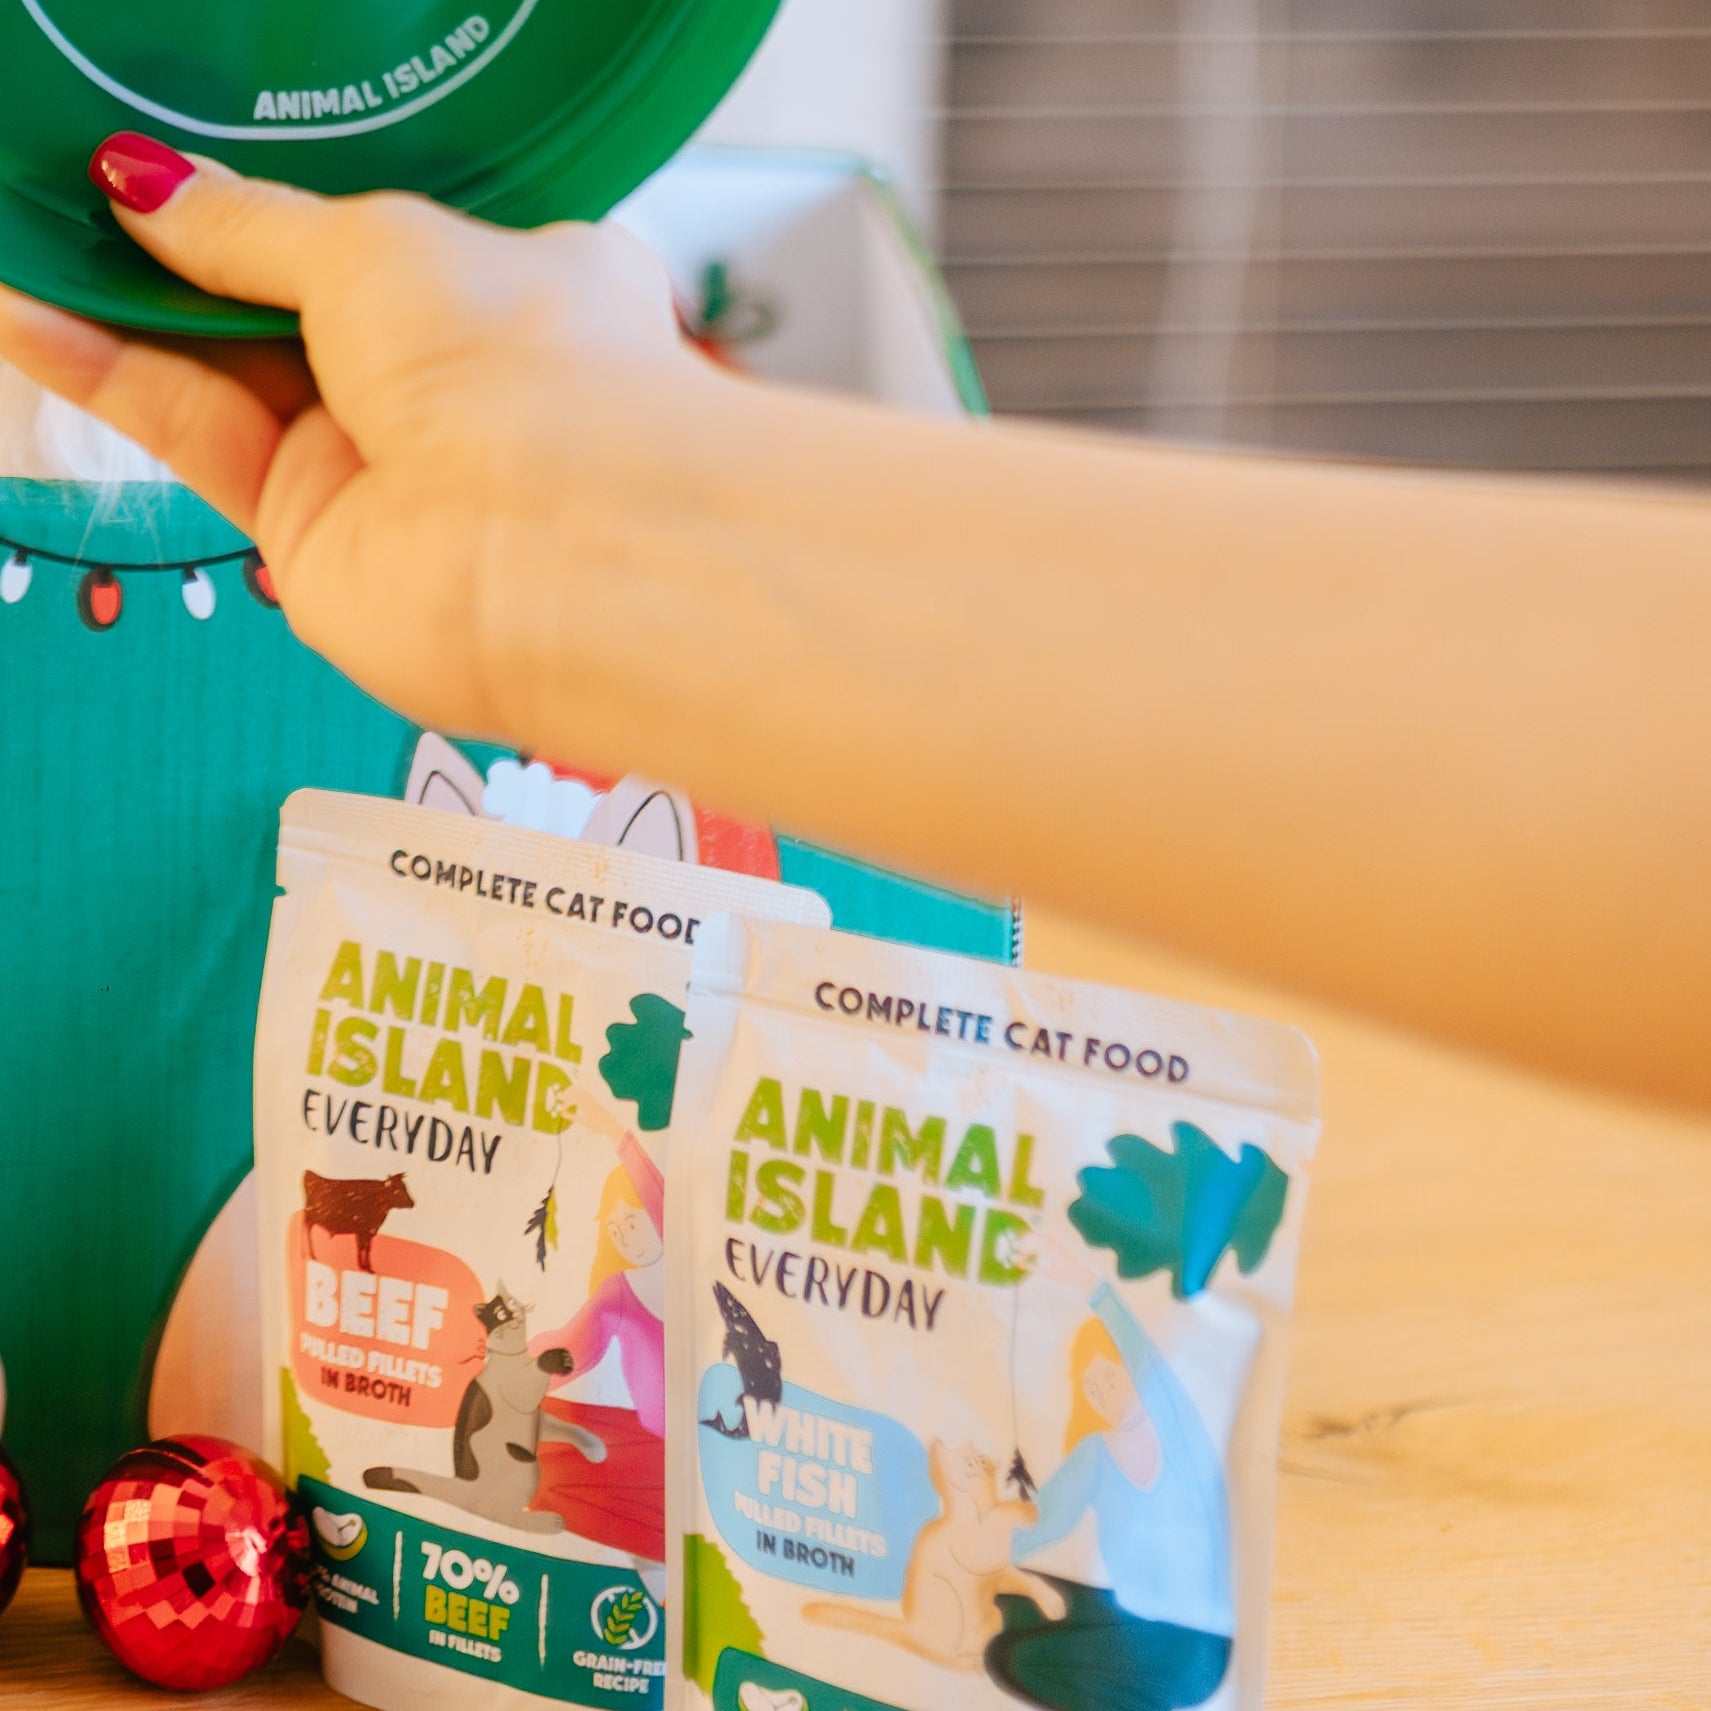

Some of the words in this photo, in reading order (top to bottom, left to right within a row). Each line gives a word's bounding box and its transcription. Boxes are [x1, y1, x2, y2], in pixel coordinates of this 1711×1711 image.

[253, 80, 383, 120] ANIMAL
[382, 15, 489, 99] ISLAND
[390, 849, 538, 908] COMPLETE
[546, 886, 605, 926] CAT
[319, 940, 582, 1064] ANIMAL
[815, 982, 992, 1045] COMPLETE
[1005, 1020, 1074, 1063] CAT
[1084, 1038, 1190, 1084] FOOD
[306, 1008, 575, 1135] ISLAND
[304, 1089, 501, 1174] EVERYDAY
[734, 1076, 1045, 1209] ANIMAL
[725, 1150, 1038, 1285] ISLAND
[305, 1259, 449, 1350] BEEF
[725, 1237, 946, 1332] EVERYDAY
[300, 1333, 365, 1369] PULLED
[368, 1350, 441, 1388] FILLETS
[321, 1367, 339, 1387] IN
[345, 1373, 412, 1407] BROTH
[743, 1394, 873, 1475] WHITE
[734, 1489, 801, 1535] PULLED
[805, 1515, 887, 1558] FILLETS
[758, 1450, 857, 1519] FISH
[421, 1541, 519, 1604] 70%
[756, 1531, 776, 1554] IN
[783, 1538, 855, 1577] BROTH
[425, 1584, 510, 1641] BEEF
[429, 1629, 446, 1646] IN
[448, 1634, 502, 1662] FILLETS
[593, 1672, 649, 1693] RECIPE
